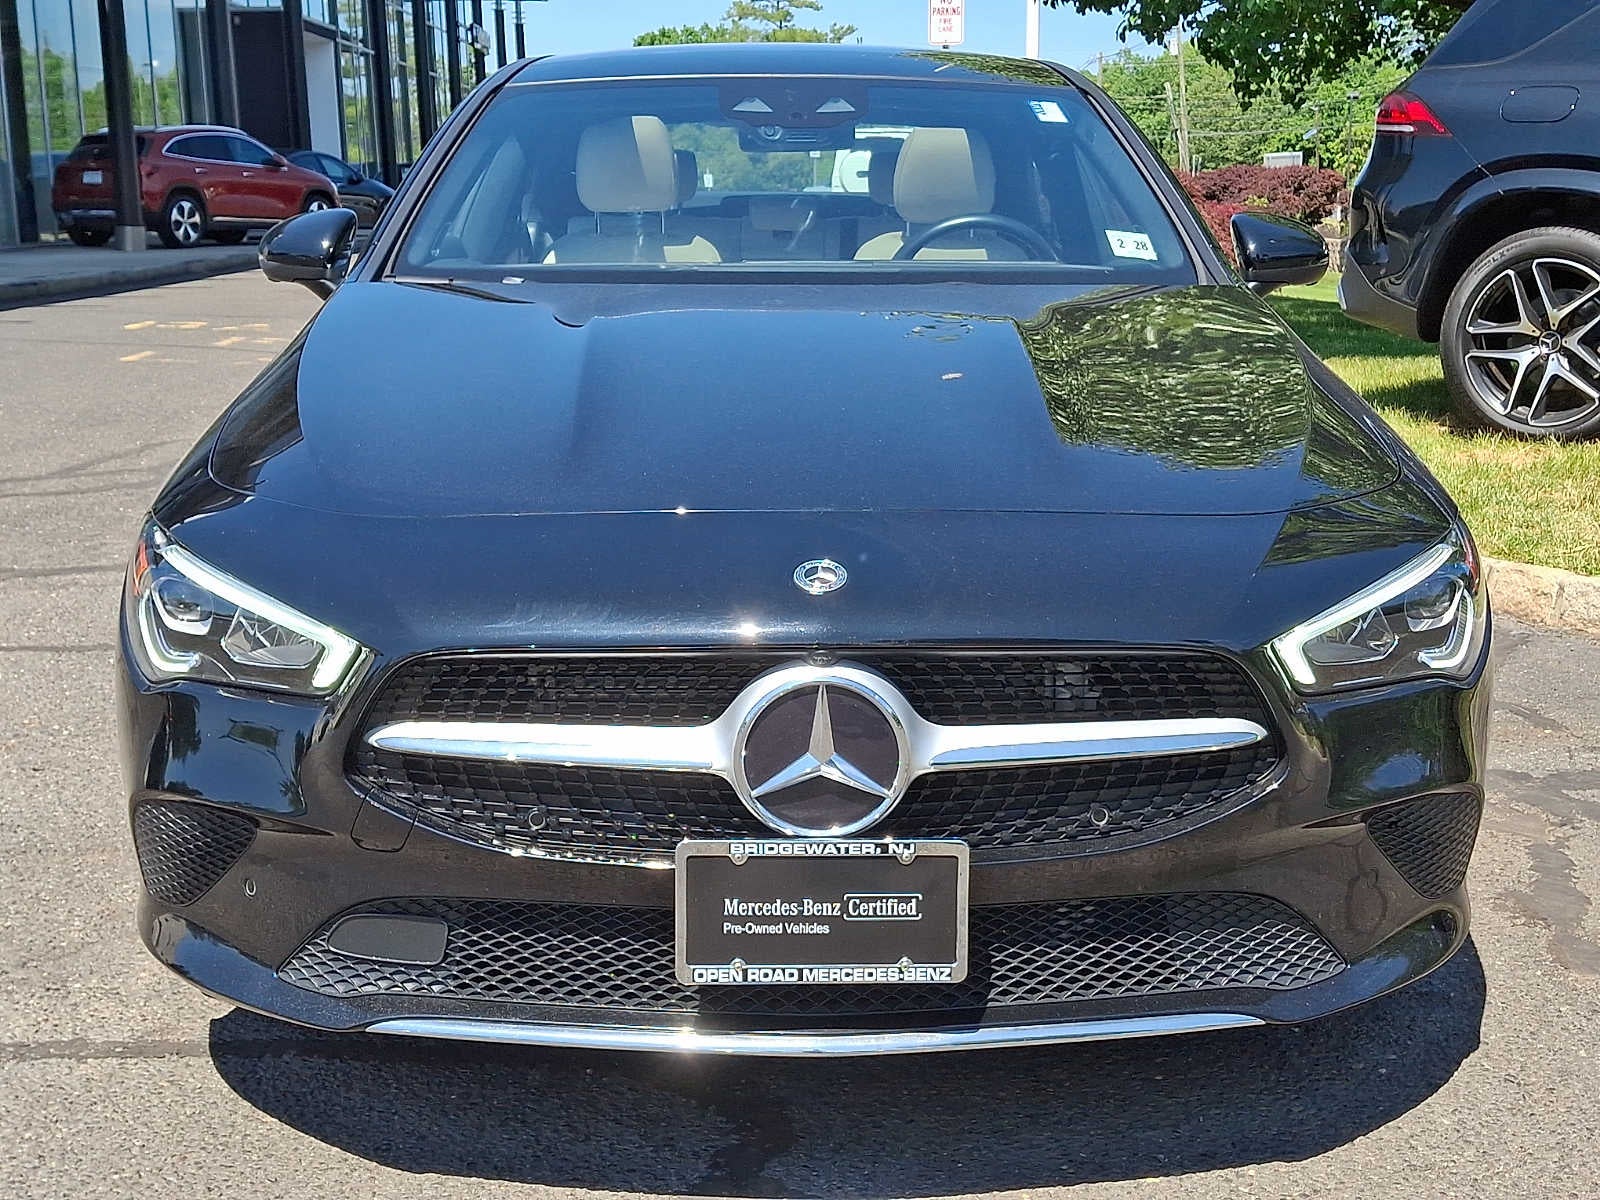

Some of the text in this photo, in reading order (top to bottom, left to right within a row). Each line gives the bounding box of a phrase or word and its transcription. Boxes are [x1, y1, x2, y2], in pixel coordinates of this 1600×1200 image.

[932, 7, 961, 16] PARKING
[1117, 239, 1148, 250] 2 28
[730, 843, 915, 855] BRIDGEWATER, NJ
[723, 898, 917, 916] Mercedes-Benz Certified
[723, 922, 830, 934] Pre-Owned Vehicles
[693, 966, 952, 983] OPEN ROAD MERCEDES-BENZ
